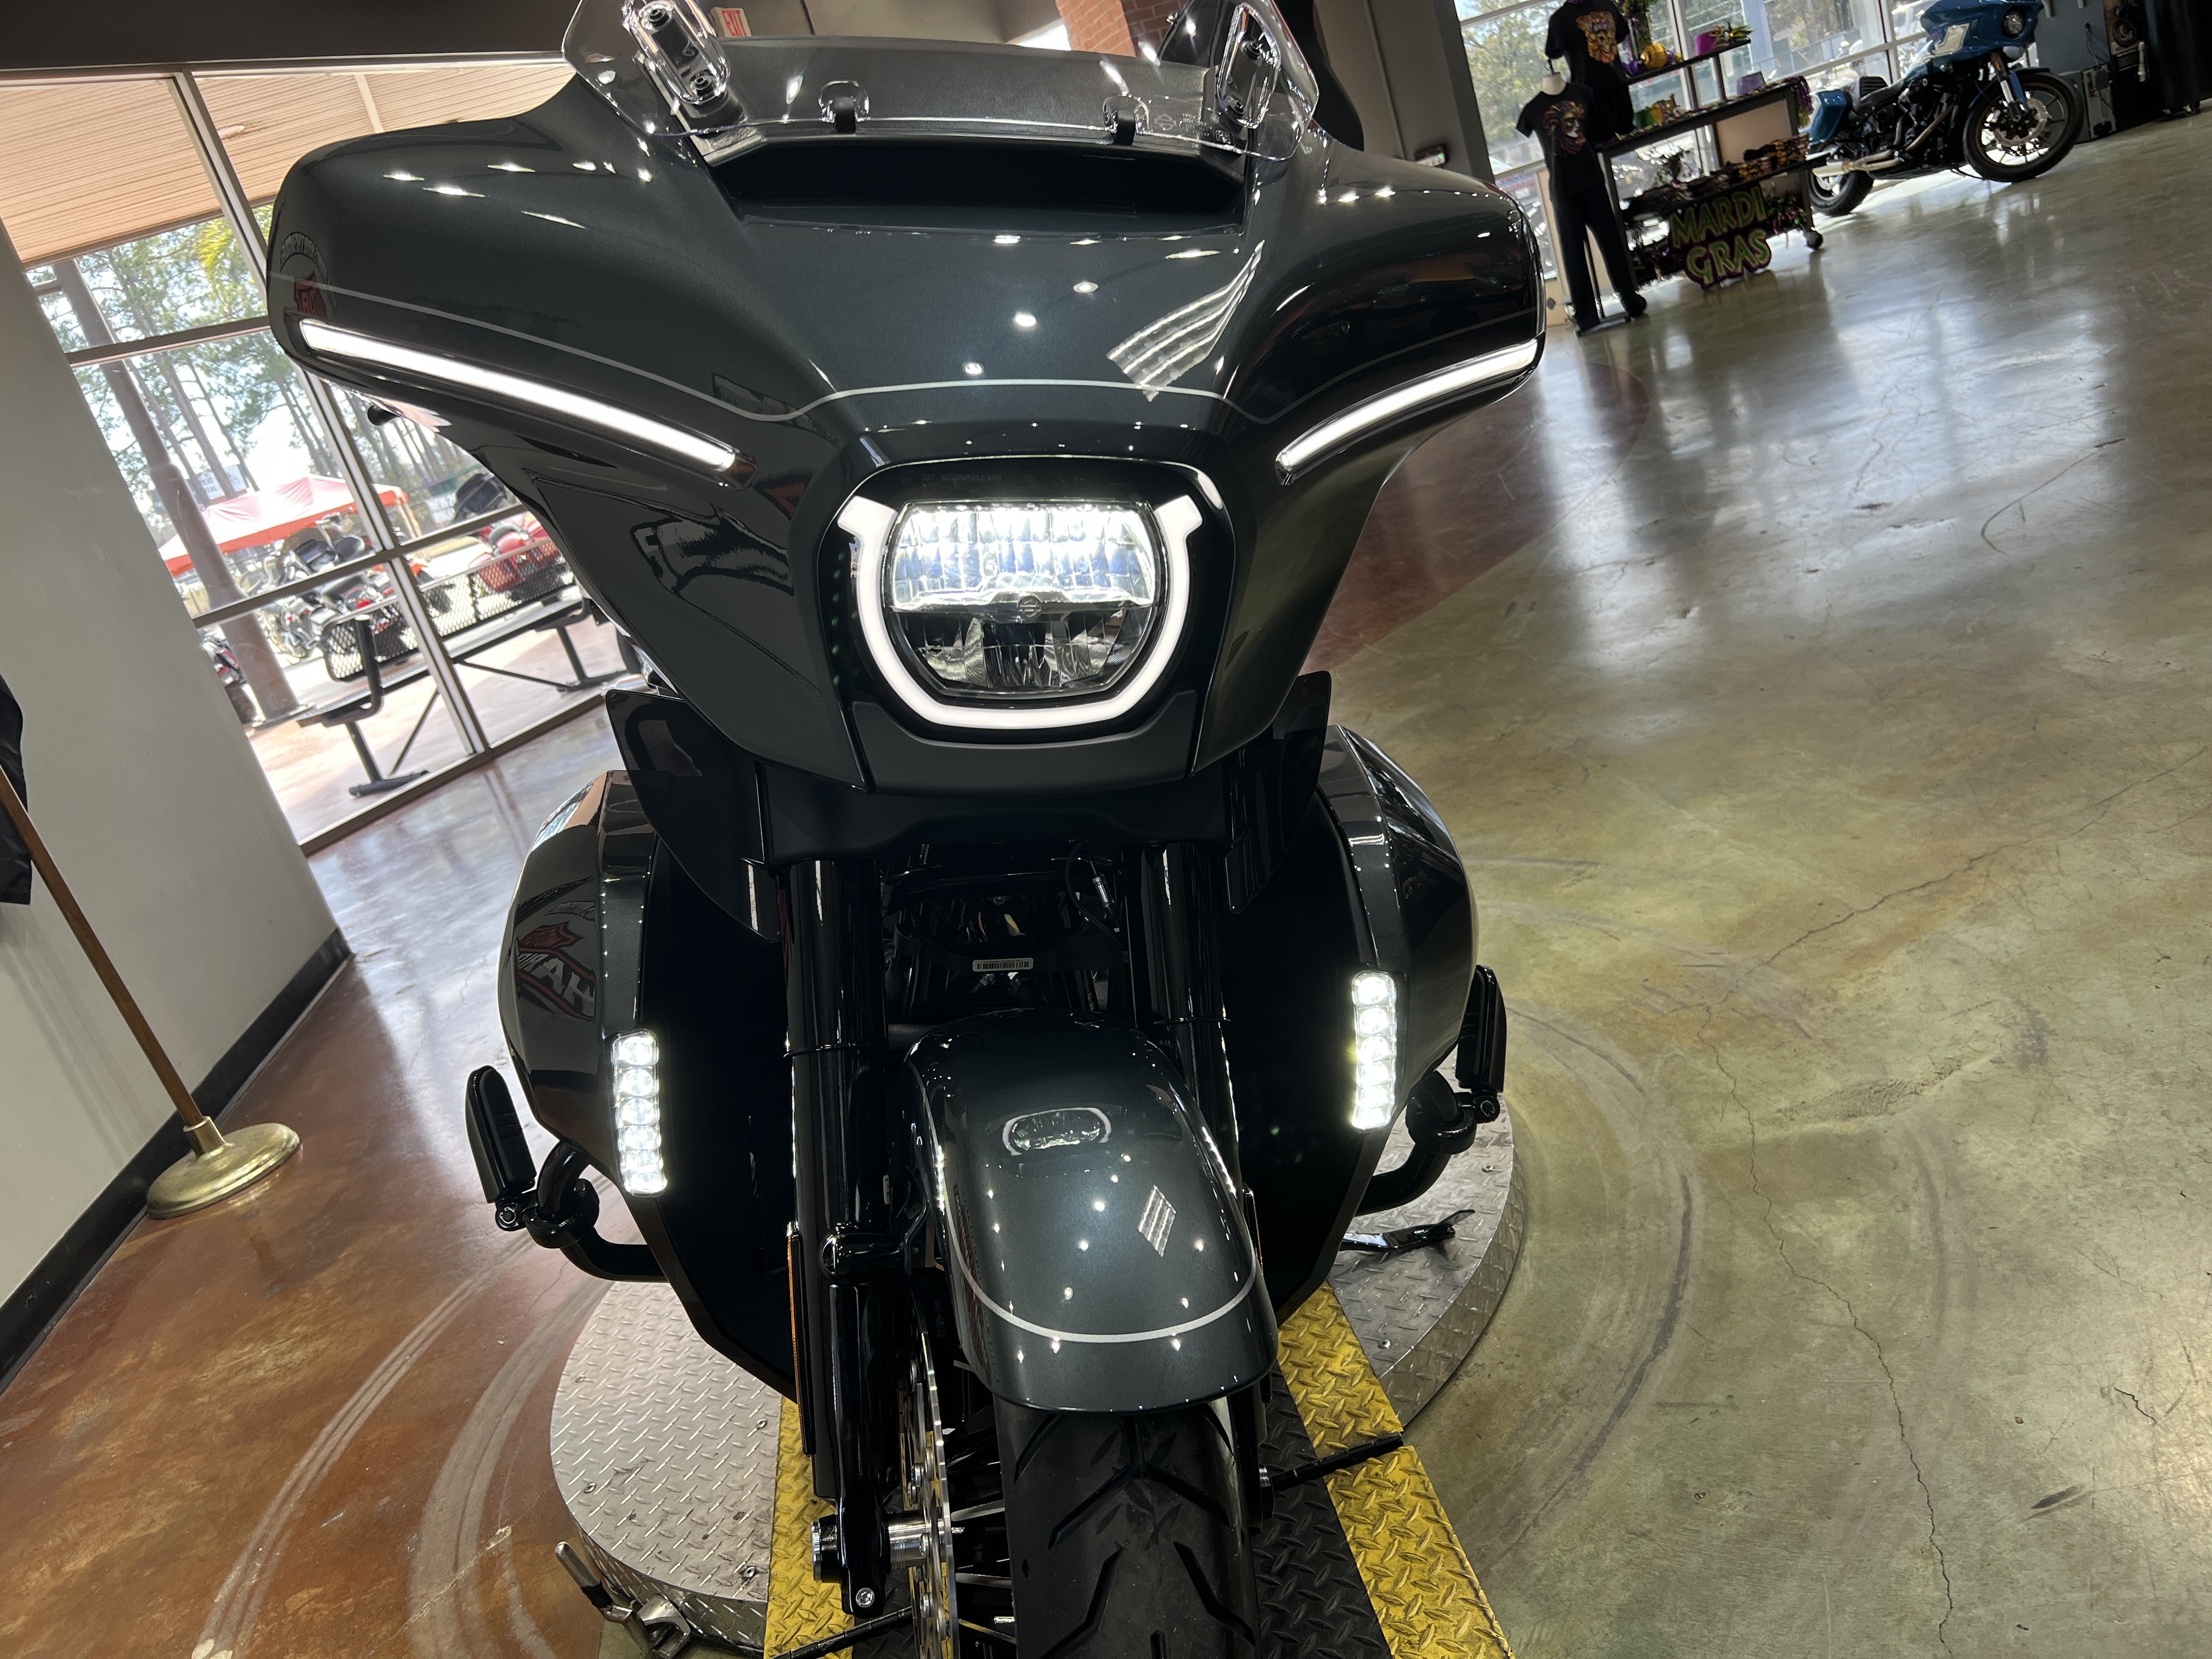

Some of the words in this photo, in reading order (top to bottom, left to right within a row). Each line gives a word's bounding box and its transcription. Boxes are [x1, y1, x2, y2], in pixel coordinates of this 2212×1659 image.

[721, 9, 747, 36] EXIT
[1669, 185, 1768, 249] MARDI
[1686, 229, 1771, 285] GRAS
